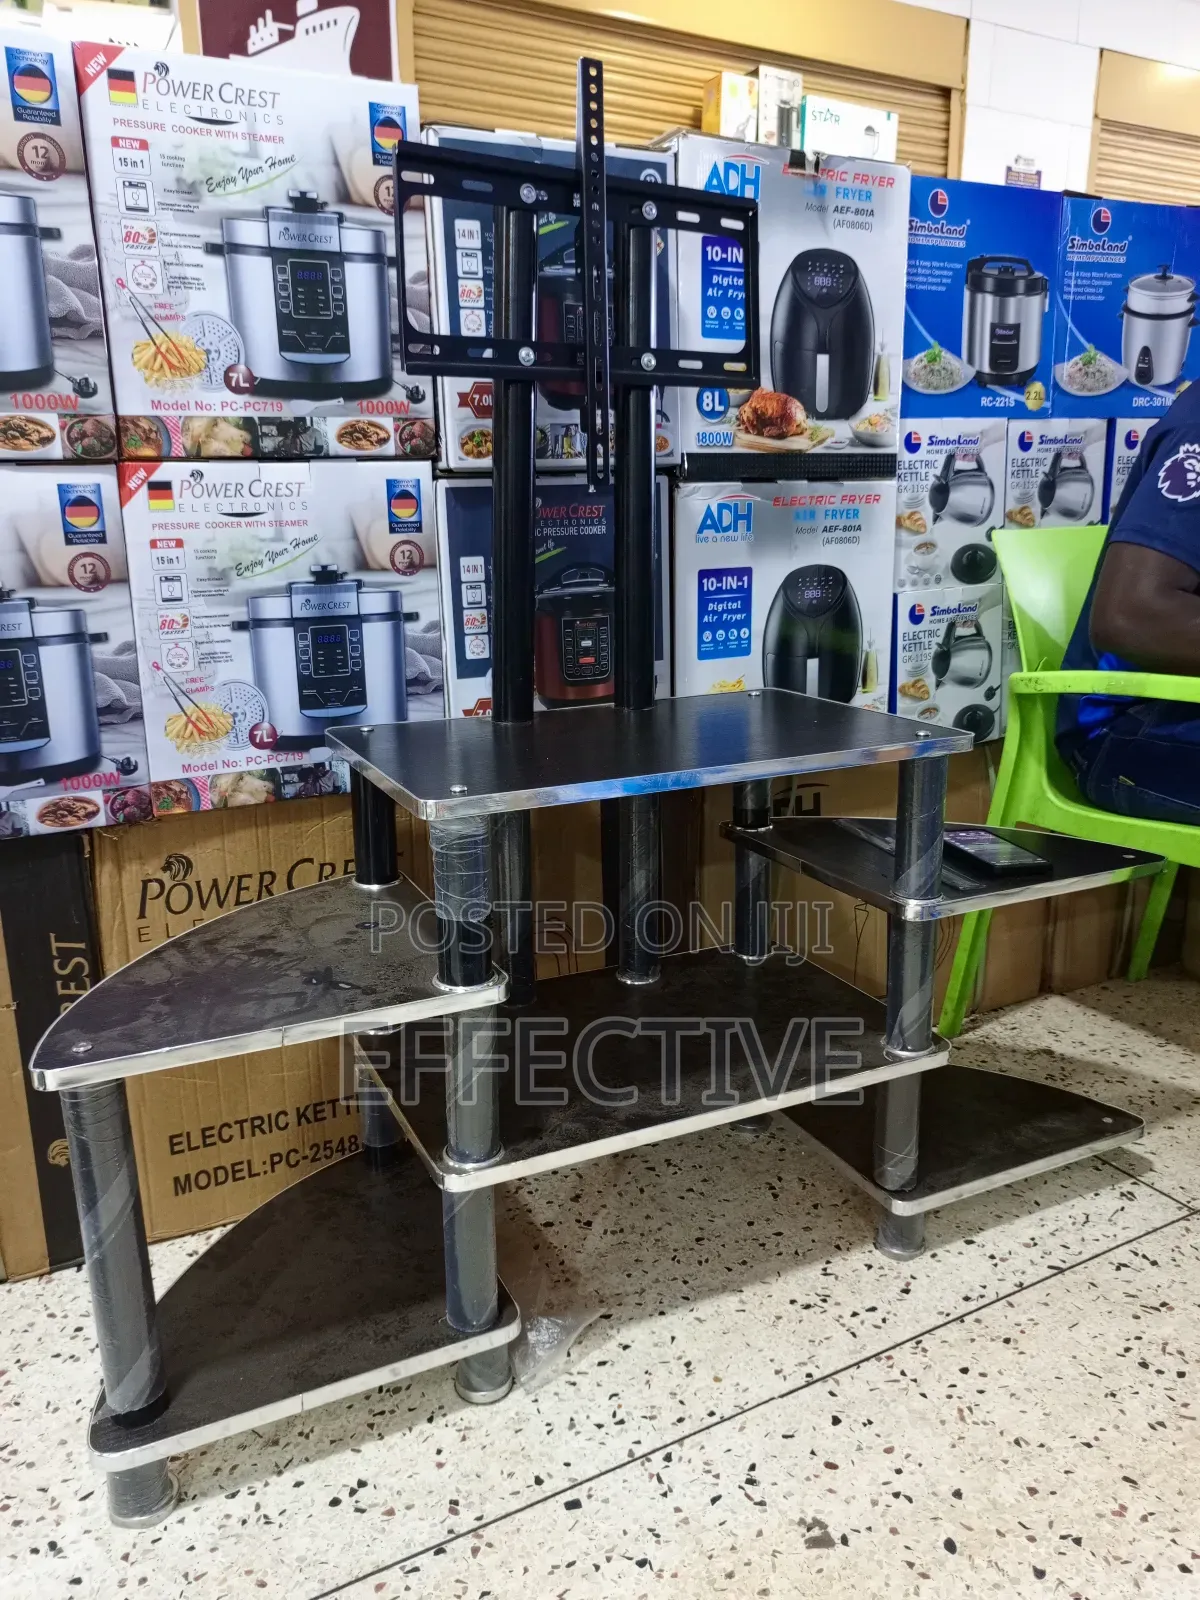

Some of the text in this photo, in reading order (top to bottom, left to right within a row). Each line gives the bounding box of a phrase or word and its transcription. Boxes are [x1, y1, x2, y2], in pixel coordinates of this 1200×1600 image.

[85, 52, 108, 76] NEW
[142, 72, 280, 110] POWER CREST
[142, 99, 284, 126] ELECTRONICS
[113, 118, 285, 145] PRESSURE COOKER WITH STEAMER
[118, 138, 140, 150] NEW
[32, 145, 49, 160] 12
[118, 157, 144, 169] 15 in 1
[206, 176, 238, 193] Enjoy
[238, 166, 264, 182] Your
[265, 154, 296, 171] Home
[852, 173, 896, 188] FRYER
[835, 186, 873, 203] FRYER
[805, 202, 875, 218] Model AEF-801A
[832, 218, 873, 234] (AF0806D)
[124, 230, 148, 244] 80%
[279, 230, 334, 244] POWER CREST
[458, 228, 466, 239] 14
[468, 229, 475, 240] IN
[1068, 236, 1128, 254] SimbaLand
[706, 288, 724, 297] Air
[228, 372, 250, 388] 7L
[10, 392, 80, 412] 1000W
[151, 400, 283, 412] Model No: PC-PC719
[356, 400, 411, 416] 1000W
[702, 392, 724, 412] 8L
[696, 431, 734, 447] 1800W
[927, 435, 980, 446] SimbaLand
[1038, 434, 1083, 445] SimbaLand
[1037, 446, 1052, 454] HOME
[898, 460, 938, 470] ELECTRIC
[1012, 458, 1047, 468] ELECTRIC
[127, 468, 148, 491] NEW
[897, 472, 930, 482] KETTLE
[1010, 468, 1039, 479] KETTLE
[179, 479, 306, 500] POWER CREST
[773, 494, 882, 507] ELECTRIC FRYER
[178, 501, 308, 514] ELECTRONICS
[536, 503, 606, 519] OWER CREST
[696, 502, 753, 534] ADH
[824, 508, 860, 521] FRYER
[152, 519, 308, 531] PRESSURE COOKER WITH STEAMER
[543, 526, 578, 537] PRESSURE
[580, 526, 607, 535] COOKER
[796, 524, 862, 535] Model AEF-801A
[156, 540, 176, 548] NEW
[696, 533, 710, 544] live
[822, 536, 861, 548] (AF0806D)
[156, 556, 180, 566] 15 in 1
[235, 533, 319, 578] Enjoy Your Home
[400, 550, 412, 560] 12
[80, 563, 96, 574] 12
[462, 564, 471, 574] 14
[472, 564, 479, 574] IN
[702, 576, 748, 592] 10-IN-1
[300, 600, 352, 611] POWER CREST
[708, 600, 742, 612] Digital
[930, 603, 978, 617] SimbaLand
[703, 612, 746, 623] Air Fryer
[928, 616, 946, 625] HOME
[0, 623, 22, 632] REST
[160, 620, 180, 630] 80%
[902, 628, 941, 642] ELECTRIC
[902, 640, 932, 652] KETTLE
[186, 676, 204, 684] FREE
[254, 730, 273, 744] 7L
[182, 752, 304, 774] Model No: PC-PC719
[59, 771, 121, 792] 1000W
[138, 871, 277, 920] POWER
[168, 1110, 290, 1156] ELECTRIC
[173, 1134, 360, 1196] MODEL:PC-2548
